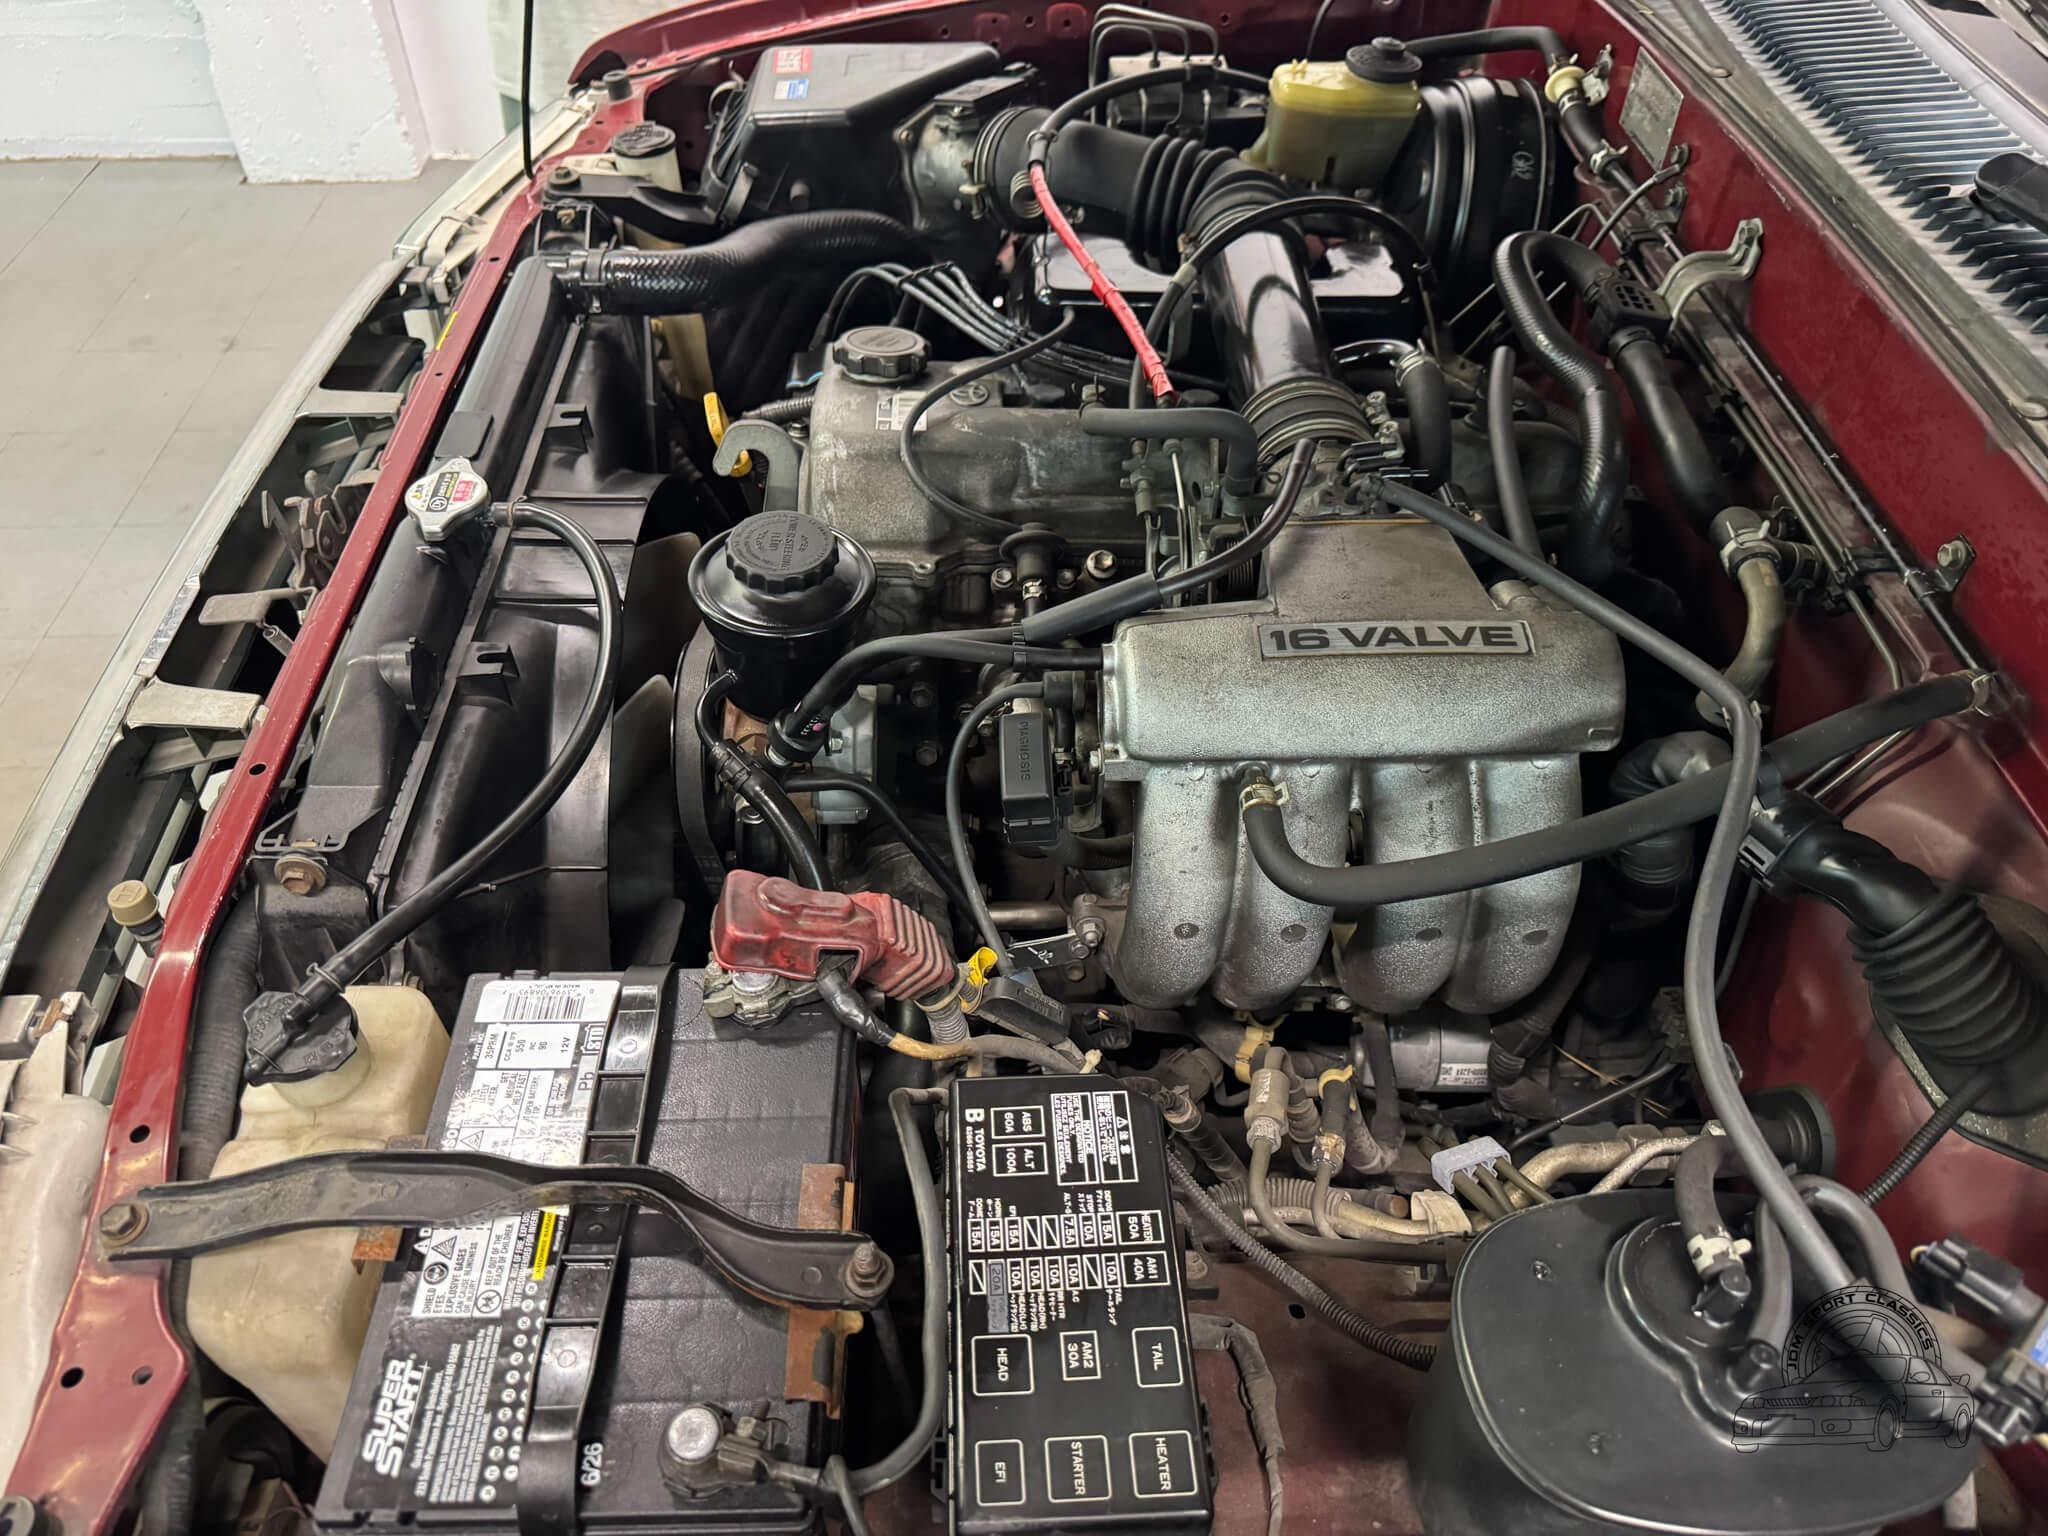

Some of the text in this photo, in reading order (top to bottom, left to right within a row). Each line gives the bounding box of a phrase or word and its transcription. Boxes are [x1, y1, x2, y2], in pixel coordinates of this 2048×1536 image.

[1270, 626, 1518, 650] 16 VALVE
[1018, 720, 1031, 781] DIAGNOSIS
[504, 1049, 512, 1061] CCA
[560, 1036, 572, 1053] 12V
[577, 1072, 595, 1090] Pb
[965, 1108, 984, 1122] B
[1003, 1112, 1014, 1132] 60A
[1021, 1111, 1032, 1131] ABS
[1083, 1120, 1094, 1154] NOTICE
[974, 1128, 985, 1171] TOYOTA
[1006, 1148, 1016, 1172] 100A
[1023, 1148, 1034, 1168] ALT
[975, 1198, 983, 1217] DOME
[1085, 1194, 1094, 1212] STOP
[543, 1212, 552, 1237] WARRANT
[989, 1225, 1000, 1245] 15A
[1008, 1224, 1018, 1244] 15A
[1064, 1218, 1074, 1243] 7.5A
[1083, 1220, 1093, 1240] 10A
[1101, 1219, 1112, 1239] 15A
[1127, 1216, 1139, 1238] 50A
[1140, 1211, 1152, 1241] HEATER
[970, 1226, 981, 1246] 15A
[456, 1242, 477, 1313] CAN CAUSE BLINDNESS
[485, 1270, 493, 1285] KEEP
[489, 1256, 497, 1268] OUT
[493, 1264, 503, 1285] REACH
[991, 1267, 1001, 1290] 20A
[1010, 1265, 1021, 1286] 10A
[1029, 1265, 1040, 1285] 10A
[1048, 1263, 1059, 1284] 10A
[1068, 1263, 1078, 1283] 10A
[1105, 1261, 1116, 1281] 10A
[1132, 1257, 1144, 1280] 40A
[1146, 1256, 1157, 1279] AM1
[445, 1248, 466, 1312] EXPLOSIVE GASES
[423, 1288, 435, 1313] SHIELD
[434, 1292, 445, 1313] EYES.
[1114, 1288, 1122, 1304] TAIL
[997, 1347, 1009, 1382] HEAD
[1068, 1342, 1080, 1369] 30A
[1081, 1341, 1093, 1369] AM2
[1151, 1343, 1165, 1371] TAIL
[362, 1359, 406, 1462] SUPER
[375, 1358, 423, 1478] START
[580, 1442, 604, 1486] 6/26
[994, 1461, 1007, 1483] EFI
[1071, 1441, 1086, 1496] STARTER
[1155, 1437, 1171, 1491] HEATER
